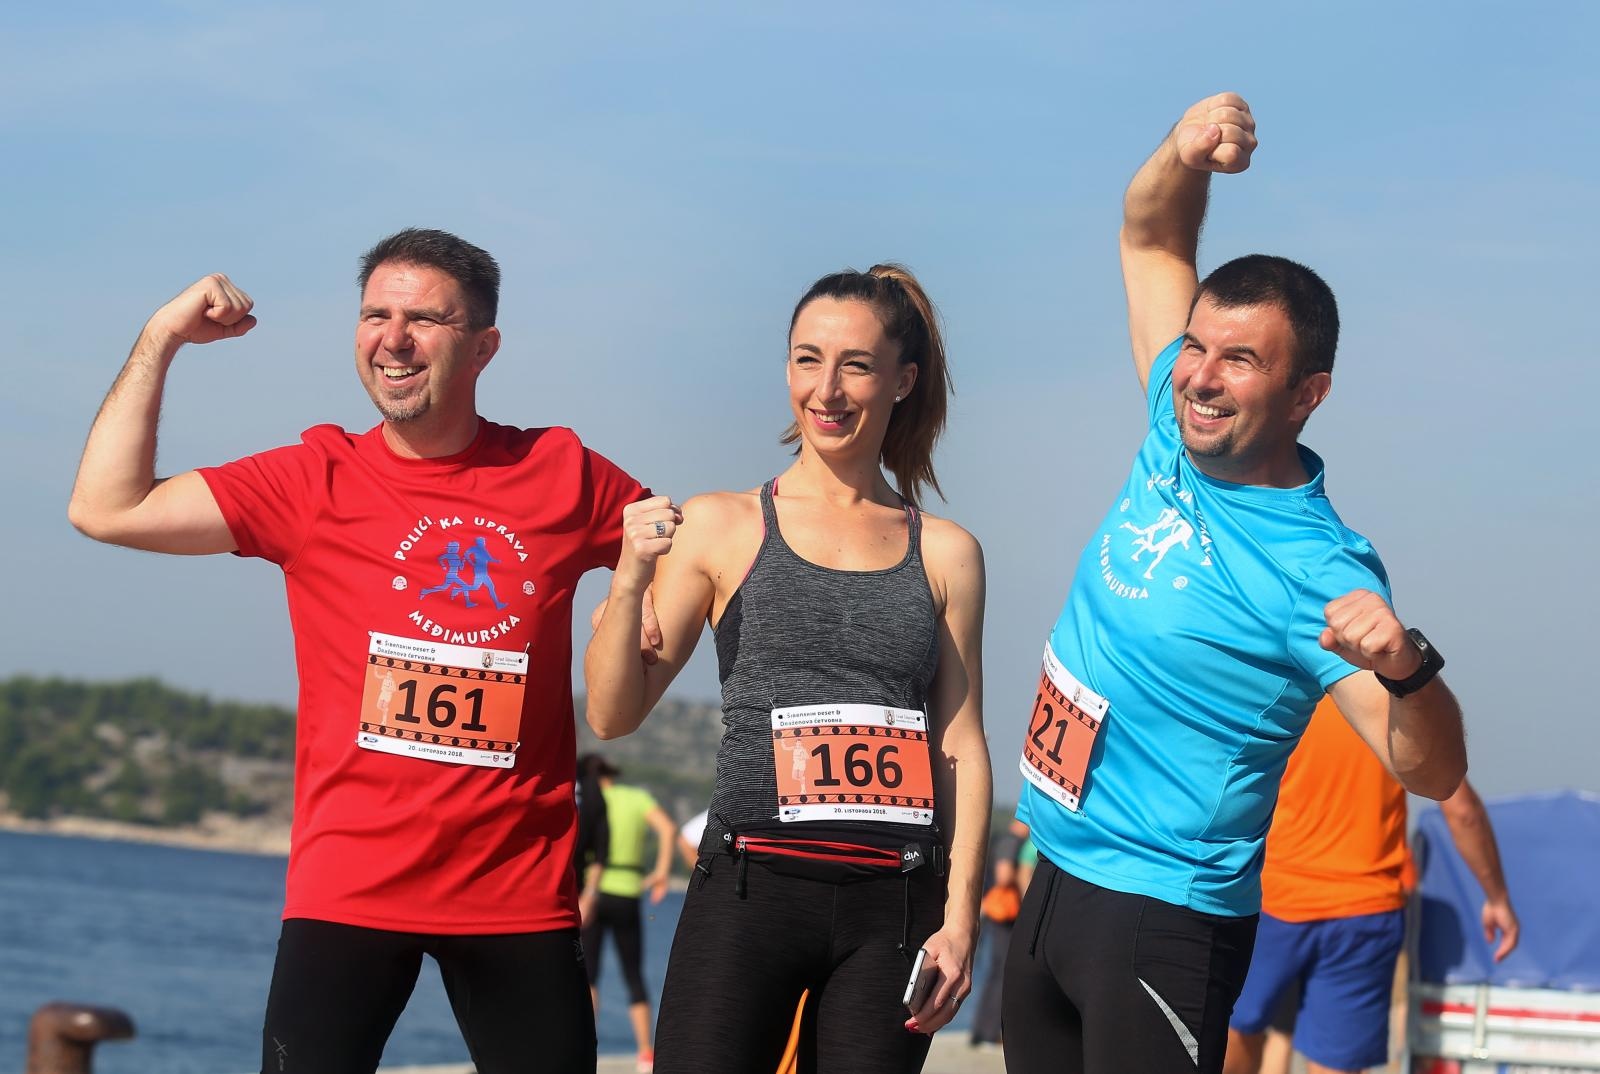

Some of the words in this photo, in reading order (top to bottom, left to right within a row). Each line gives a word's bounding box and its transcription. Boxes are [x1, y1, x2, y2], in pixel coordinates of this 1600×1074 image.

[474, 516, 528, 562] UPRAVA
[408, 610, 522, 644] MEĐIMURSKA
[394, 679, 487, 732] 161
[811, 743, 903, 789] 166
[903, 850, 920, 862] vip
